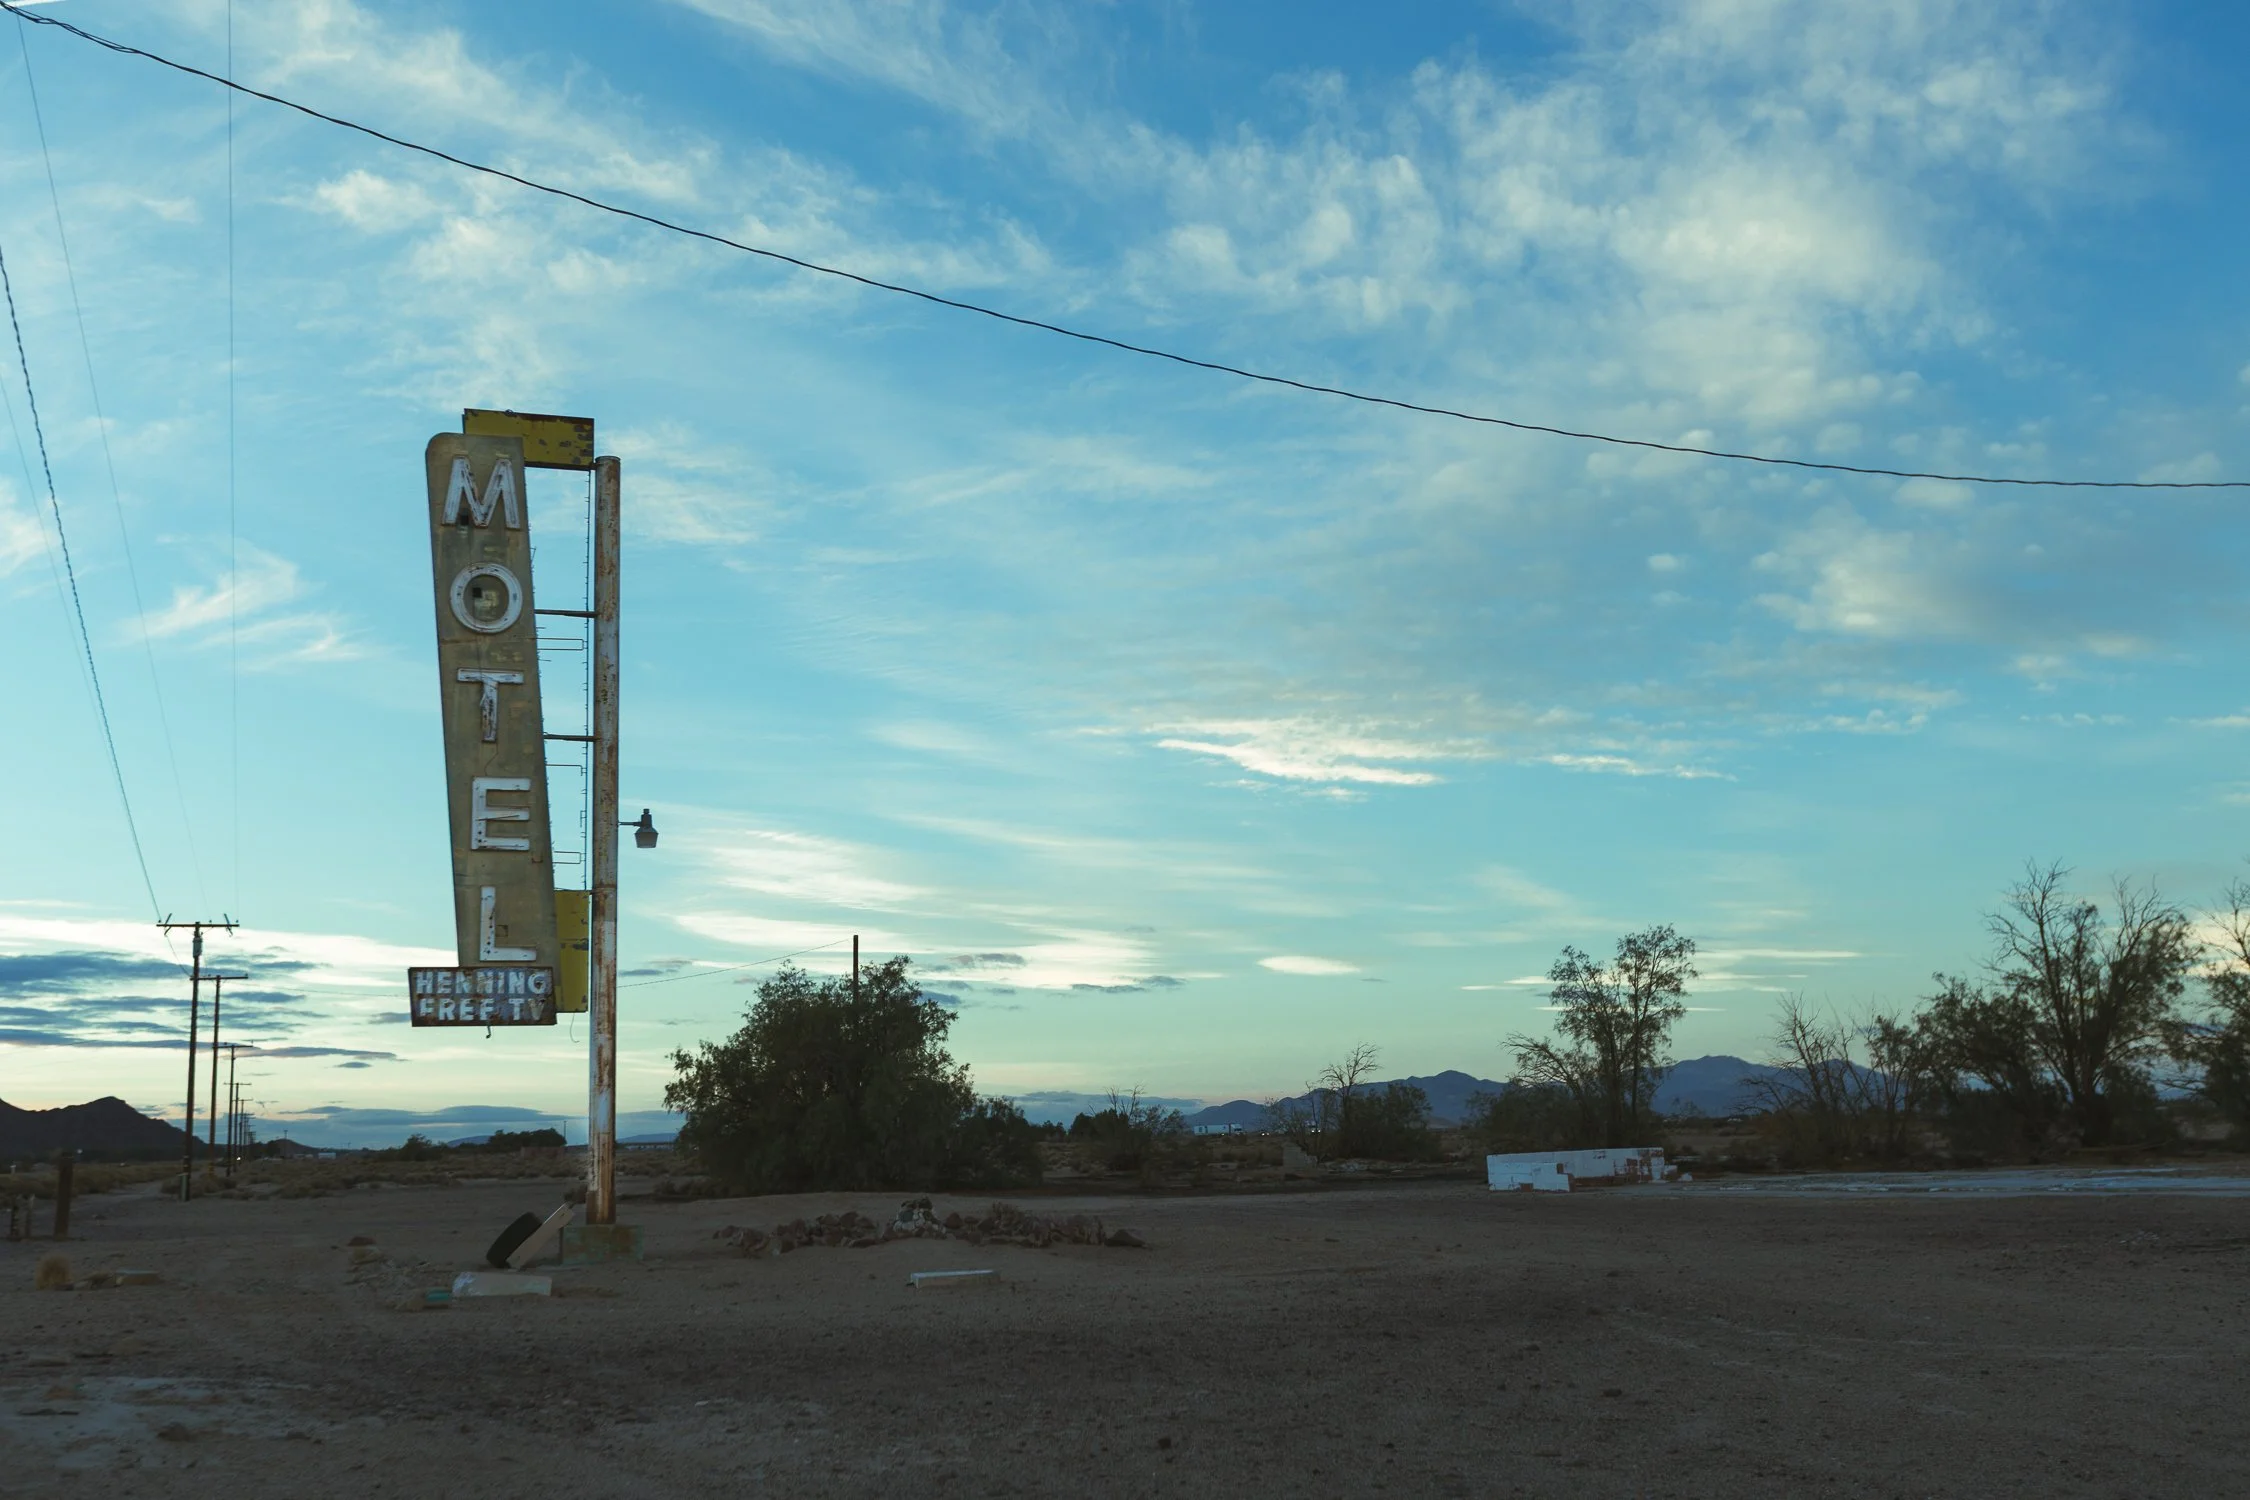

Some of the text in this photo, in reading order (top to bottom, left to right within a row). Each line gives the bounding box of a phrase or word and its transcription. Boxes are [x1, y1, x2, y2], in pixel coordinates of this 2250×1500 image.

[441, 455, 537, 962] MOTEL
[415, 971, 548, 994] HENNING
[419, 998, 546, 1021] FREE TV
